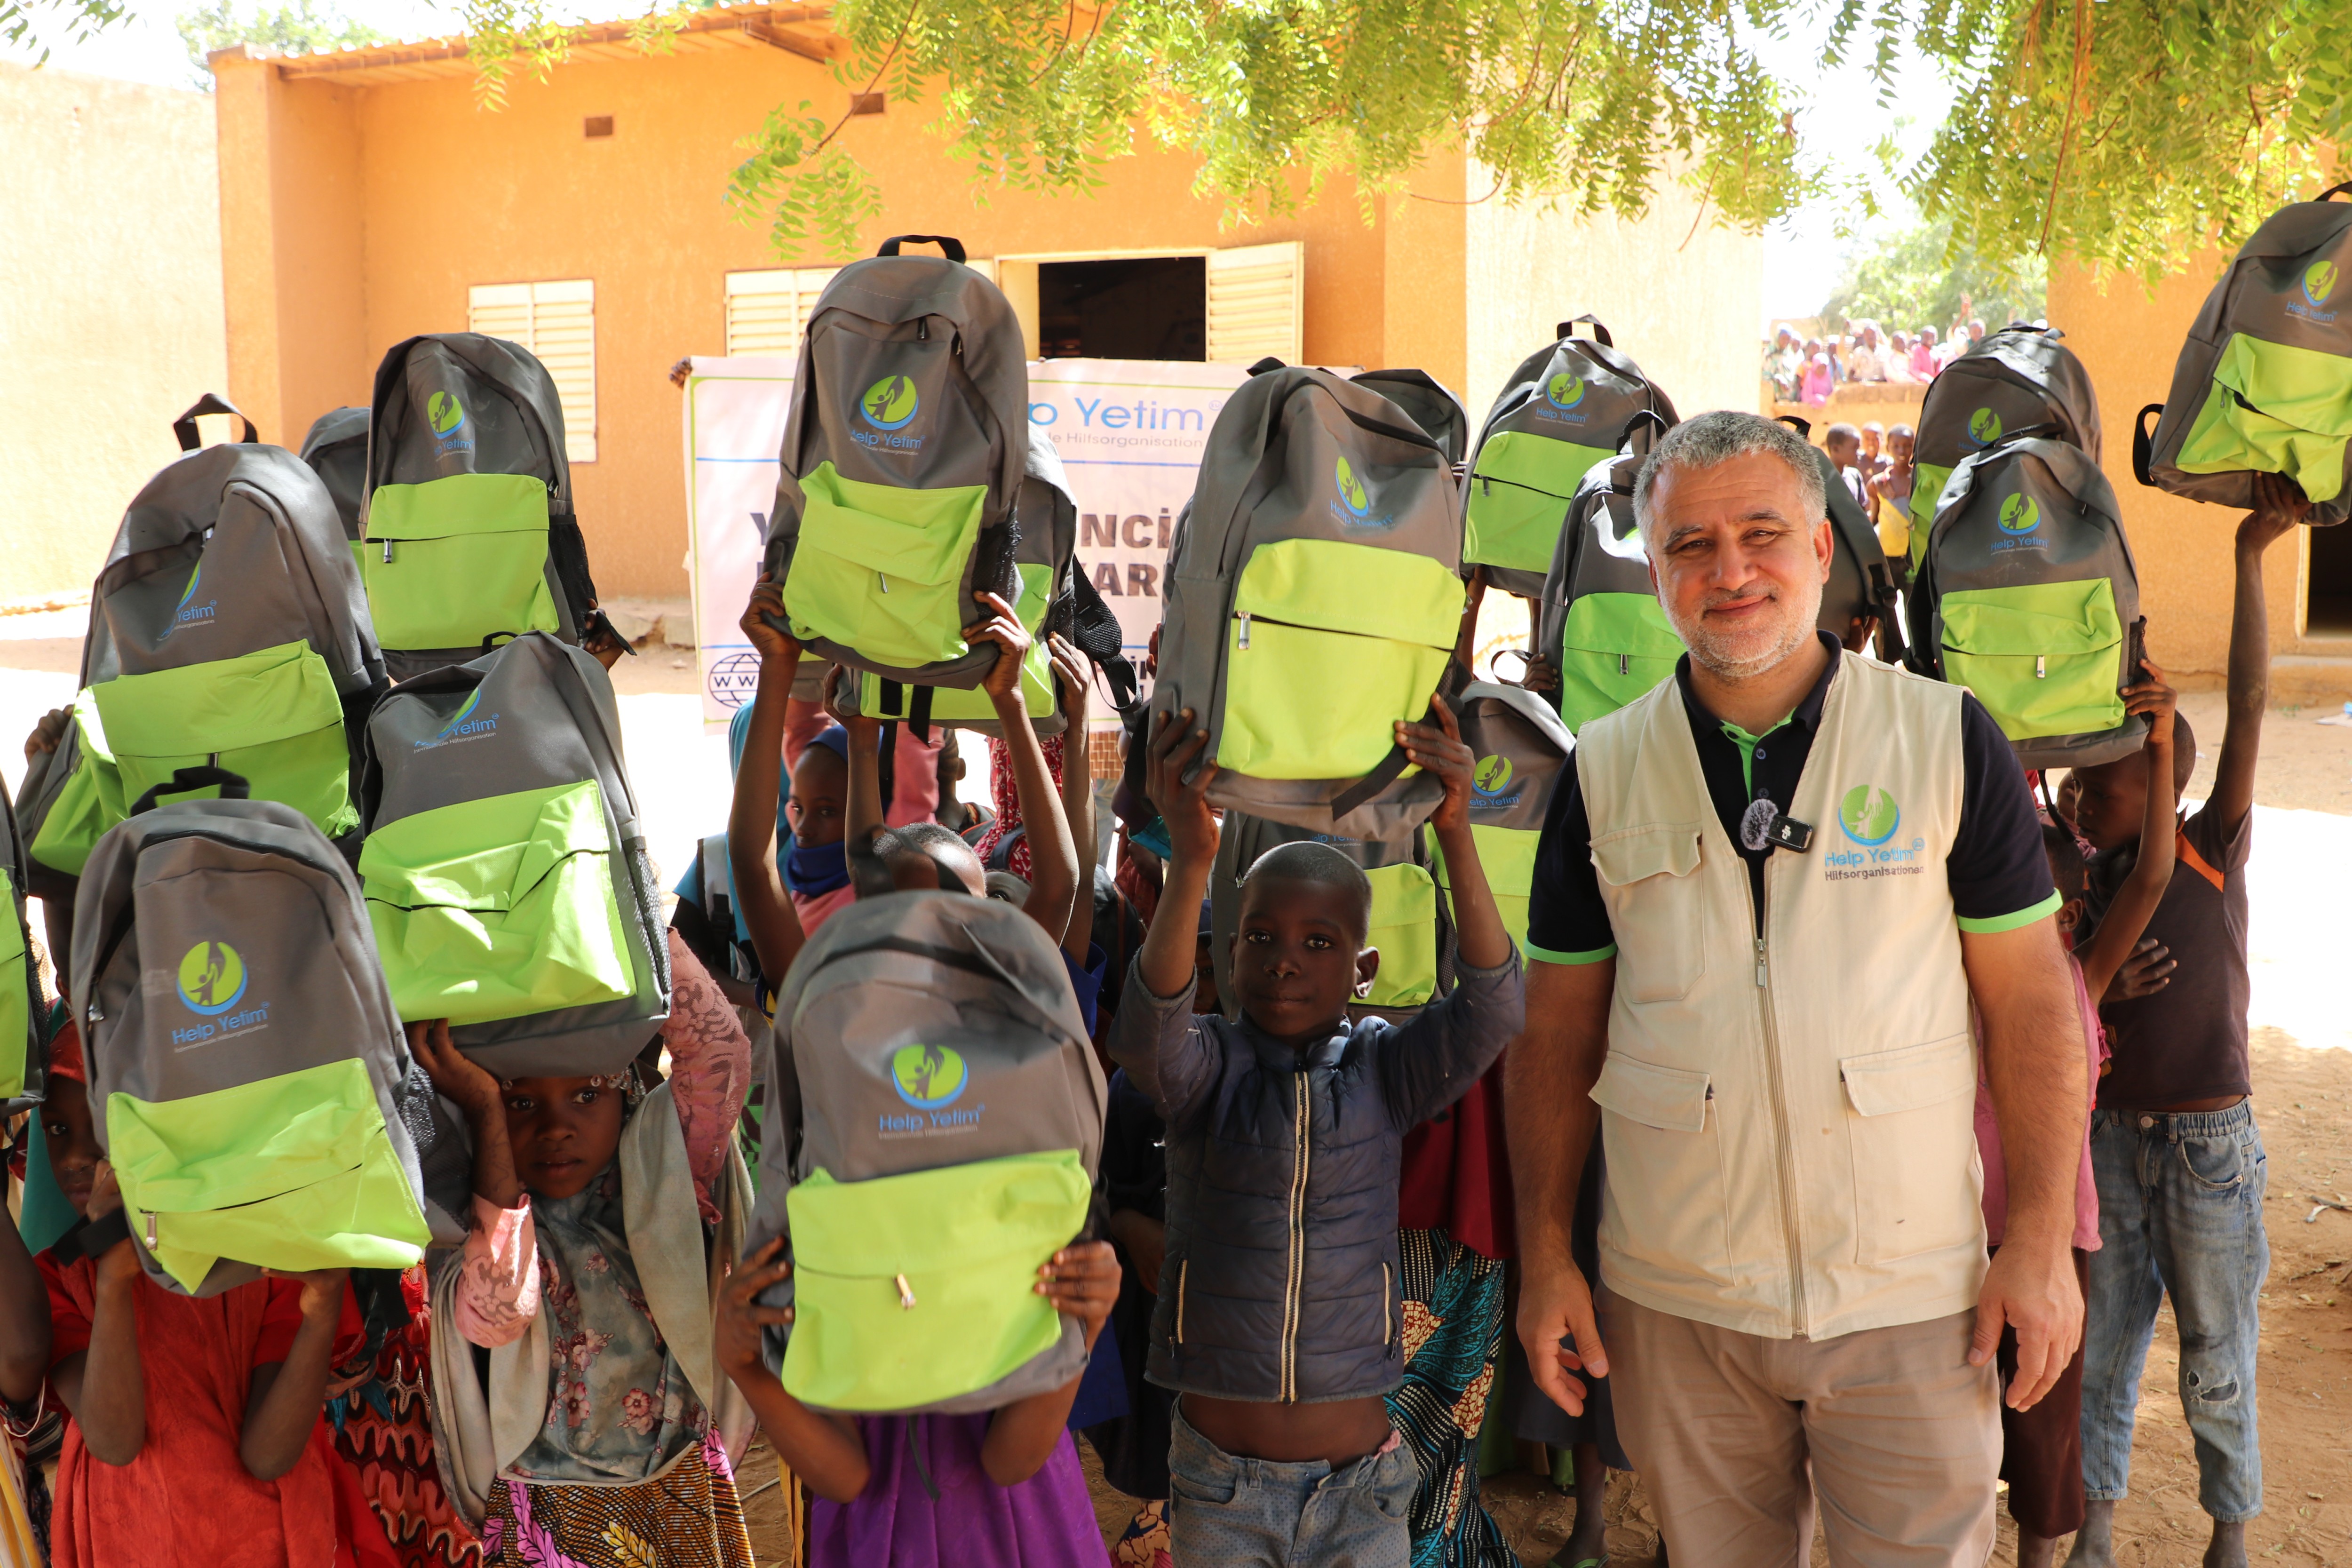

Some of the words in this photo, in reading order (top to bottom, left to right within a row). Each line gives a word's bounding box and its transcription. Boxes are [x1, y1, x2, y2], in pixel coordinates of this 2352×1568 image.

[1074, 398, 1203, 431] Yetim
[1536, 407, 1557, 419] Help
[884, 433, 922, 449] Yetim
[1067, 432, 1203, 449] Hilfsorganisation
[1991, 538, 2014, 552] Help
[1470, 798, 1486, 807] elp
[1488, 796, 1519, 806] Yetim
[1825, 850, 1865, 868] Help
[1867, 846, 1914, 863] Yetim
[1825, 866, 1924, 881] Hilfsorganisationen
[172, 1024, 215, 1045] Help
[217, 1009, 268, 1032] Yetim
[879, 1112, 923, 1134] Help
